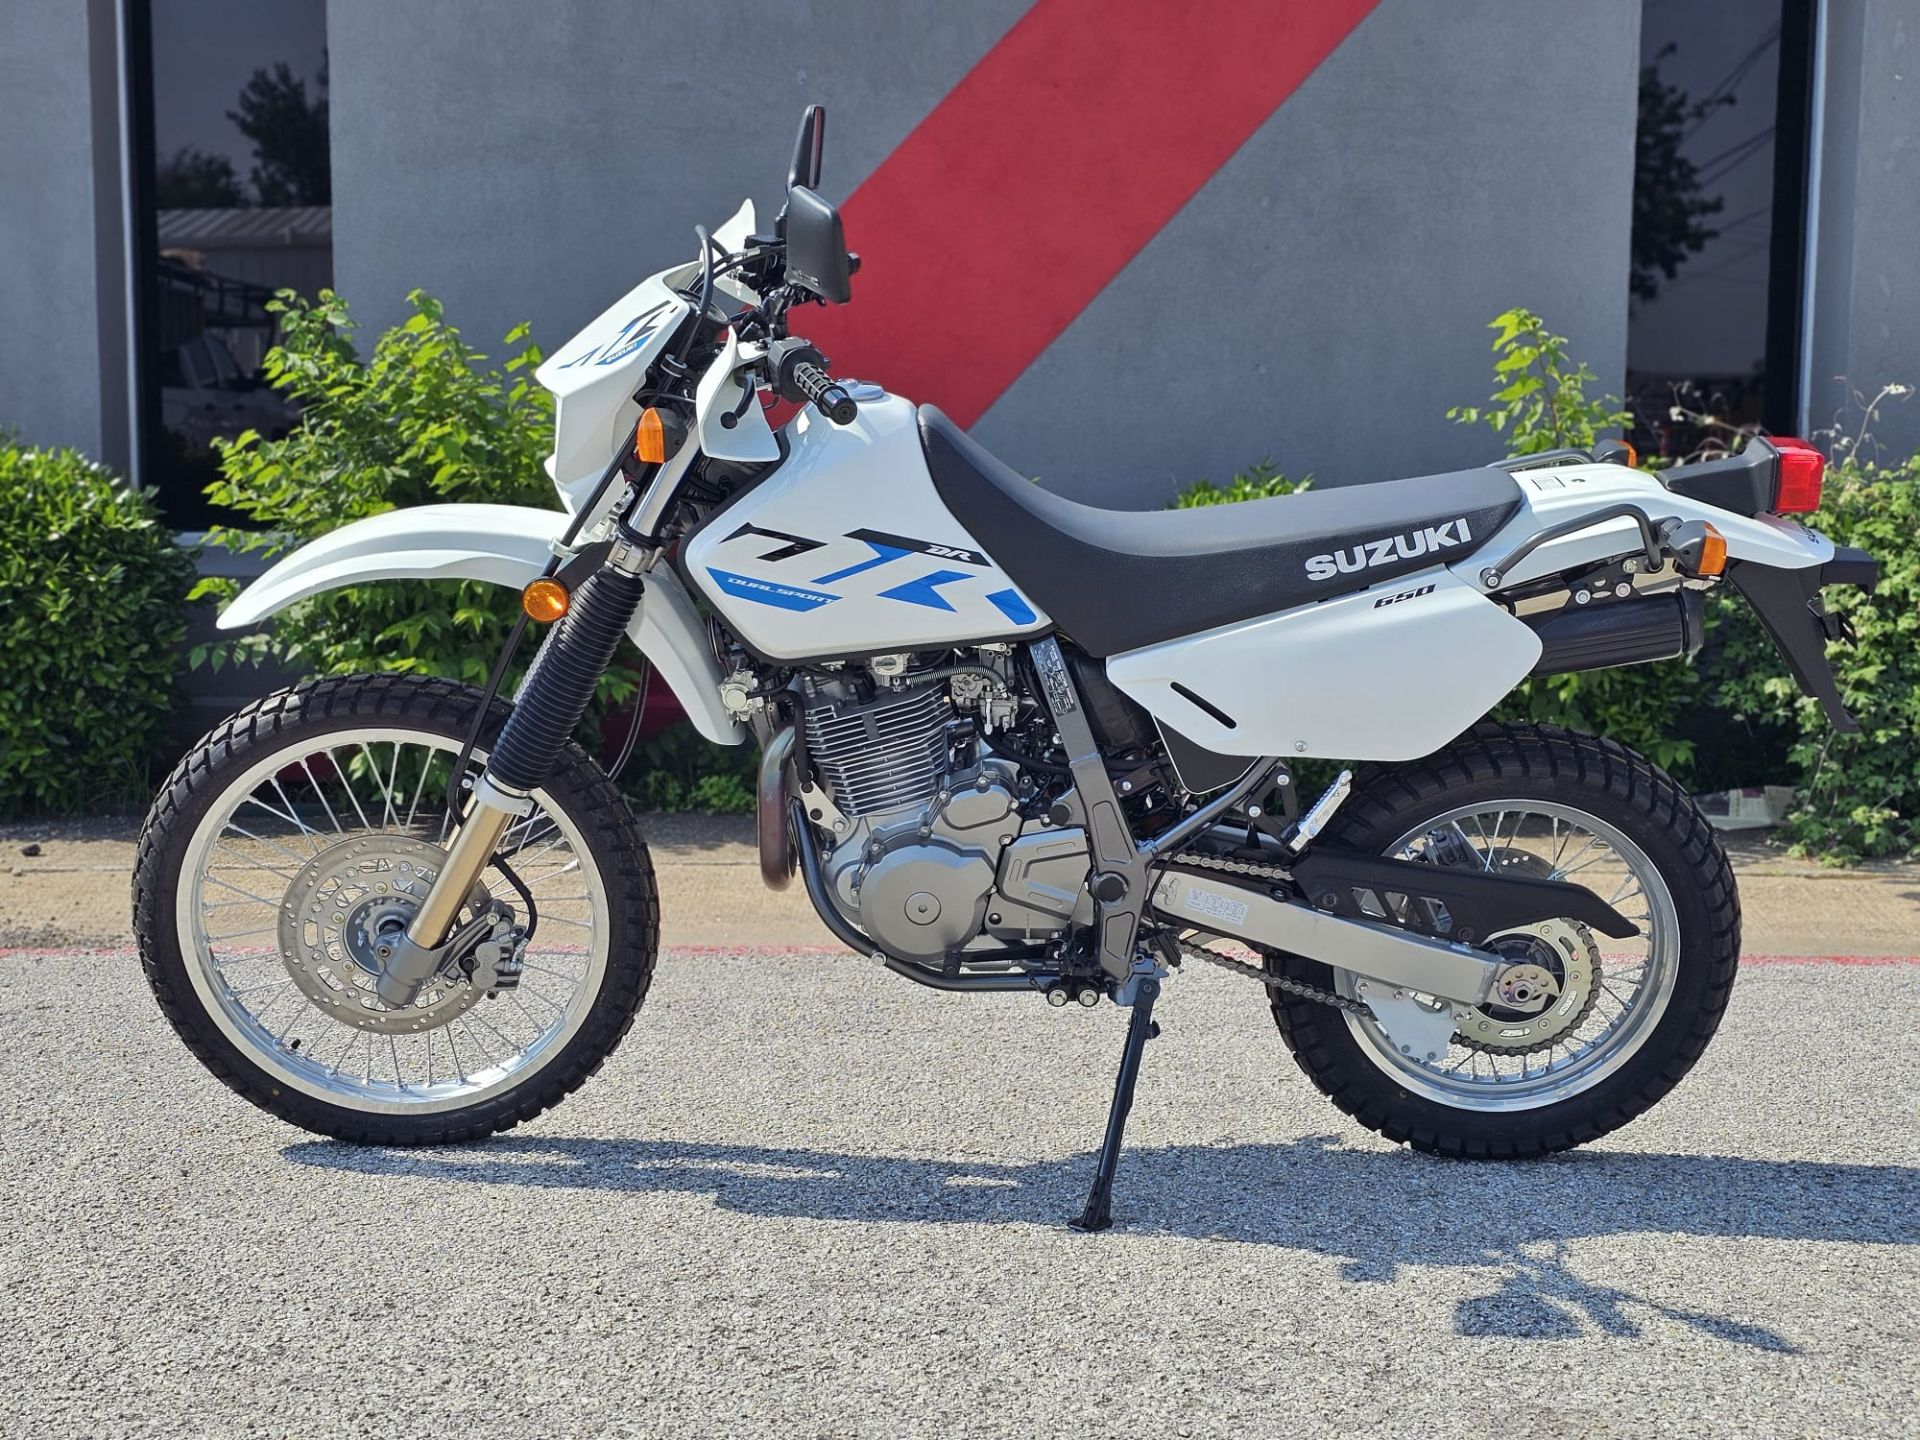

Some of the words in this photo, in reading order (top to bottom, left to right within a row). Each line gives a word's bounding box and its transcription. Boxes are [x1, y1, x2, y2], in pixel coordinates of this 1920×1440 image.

[925, 544, 972, 561] DR
[1305, 518, 1472, 581] SUZUKI
[1373, 583, 1437, 609] 650
